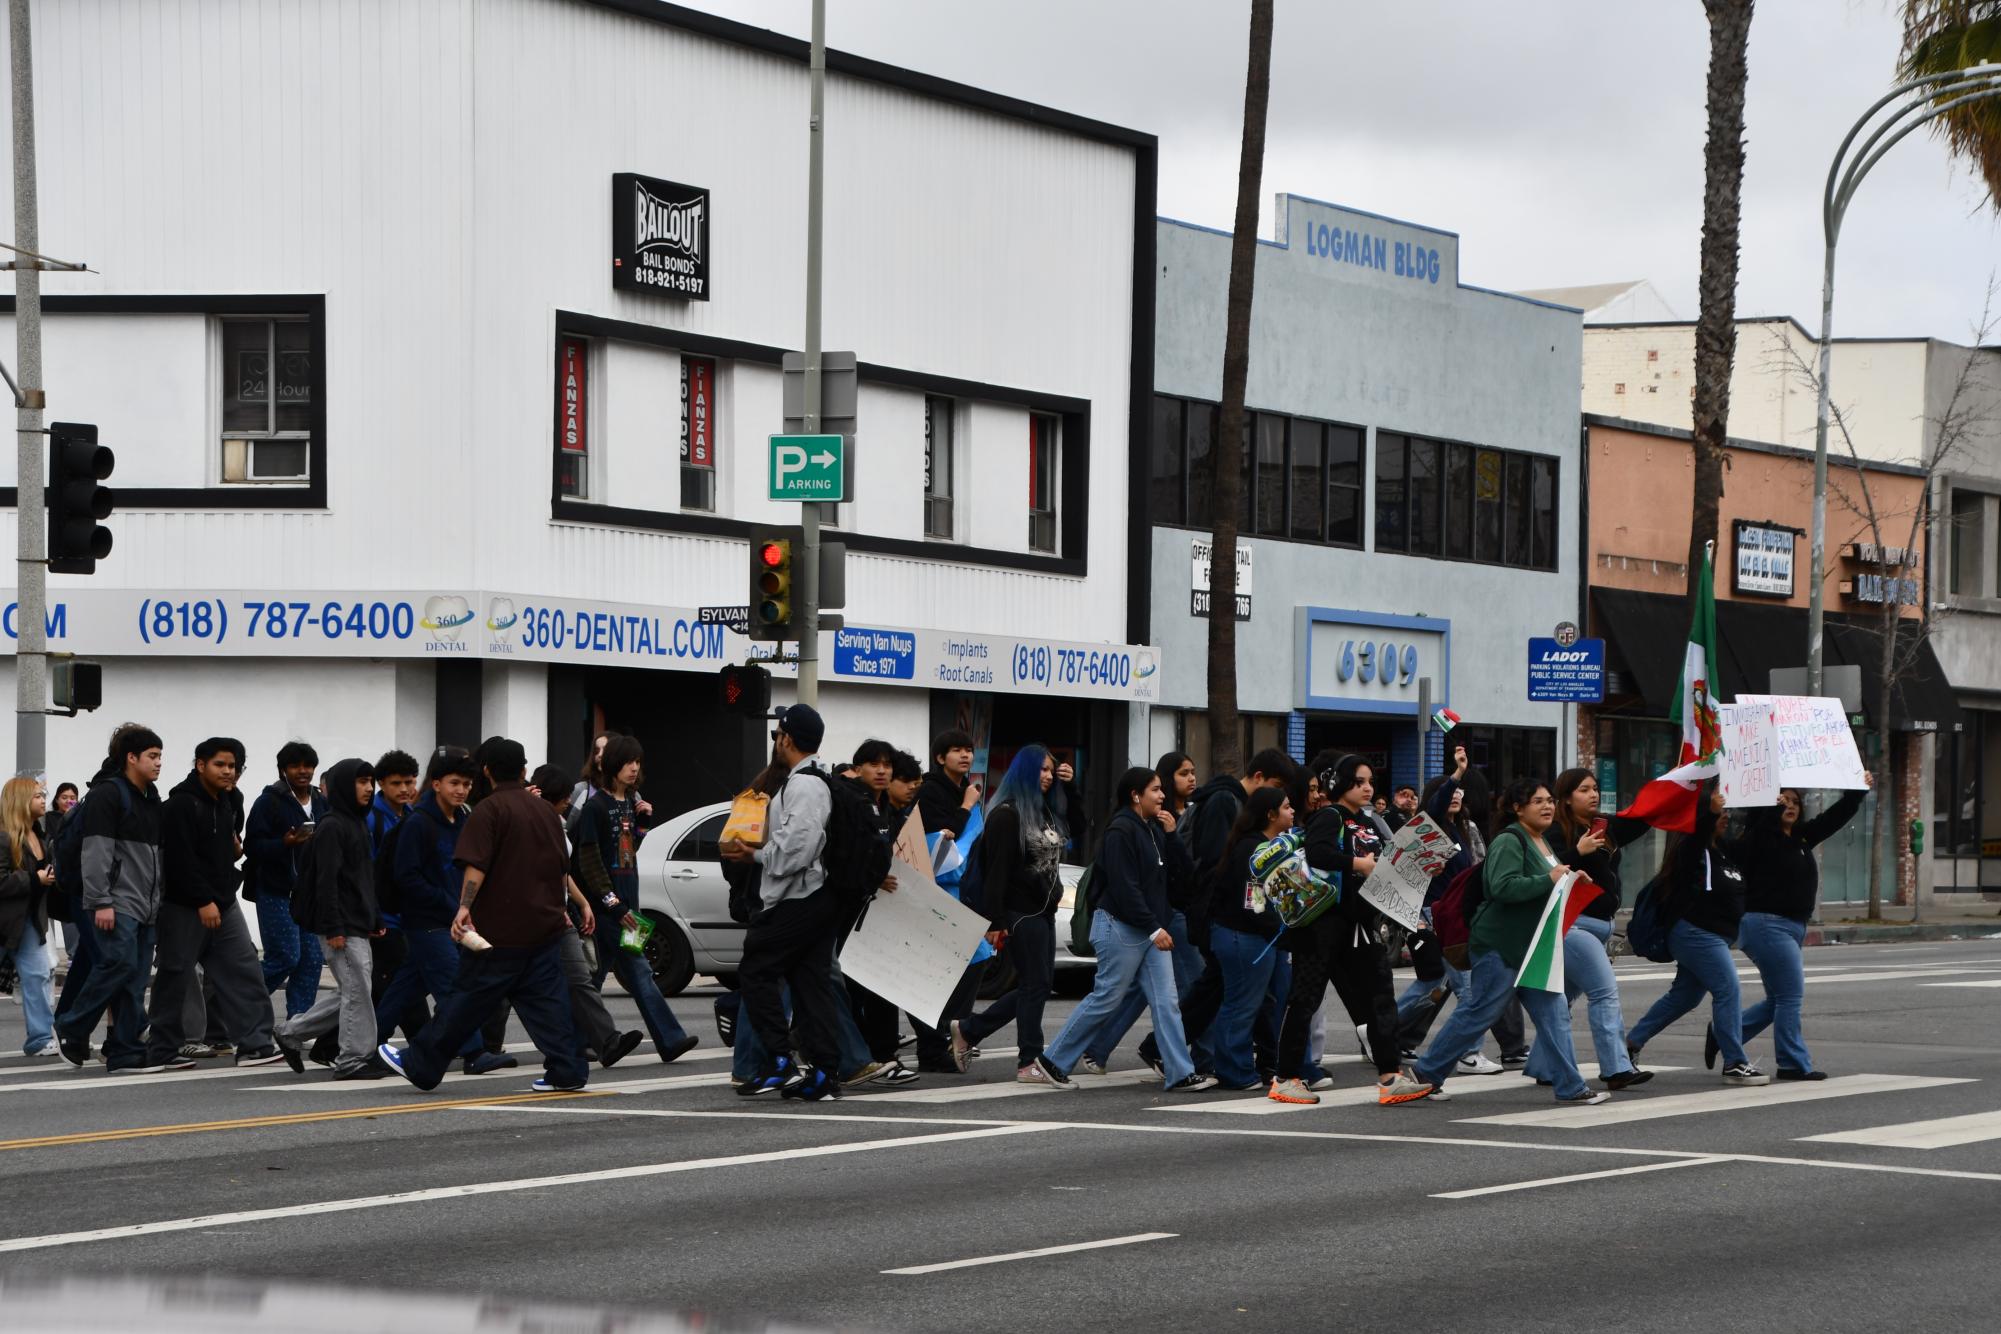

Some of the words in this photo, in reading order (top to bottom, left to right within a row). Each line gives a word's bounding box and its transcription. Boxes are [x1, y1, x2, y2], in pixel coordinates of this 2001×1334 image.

[636, 188, 702, 257] BAILOUT
[643, 251, 663, 269] BAIL
[664, 255, 695, 275] BONDS
[1307, 221, 1386, 272] LOGMAN
[1394, 241, 1440, 284] BLDG
[243, 379, 265, 397] 24
[566, 346, 577, 444] FIANZAS
[680, 364, 688, 456] BONDS
[696, 366, 706, 460] FIANZAS
[701, 608, 748, 621] SYLVAN
[1193, 592, 1211, 615] (310
[139, 599, 228, 644] (818)
[243, 601, 414, 639] 787-6400
[522, 607, 724, 659] 360-DENTAL.COM
[425, 641, 469, 652] DENTAL
[490, 643, 513, 653] DENTAL
[838, 630, 871, 655] Serving
[873, 633, 889, 651] Van
[890, 635, 912, 657] Nuys
[948, 639, 988, 661] Implants
[853, 655, 877, 674] Since
[879, 657, 896, 675] 1971
[1012, 643, 1052, 687] (818)
[1058, 649, 1130, 687] 787-6400
[1337, 640, 1418, 687] 6309
[1542, 651, 1589, 662] LADOT
[940, 664, 962, 682] Root
[964, 666, 993, 684] Canals
[1134, 688, 1152, 697] DENTAL
[1738, 721, 1760, 744] MAKE
[1727, 736, 1772, 771] AMERICA
